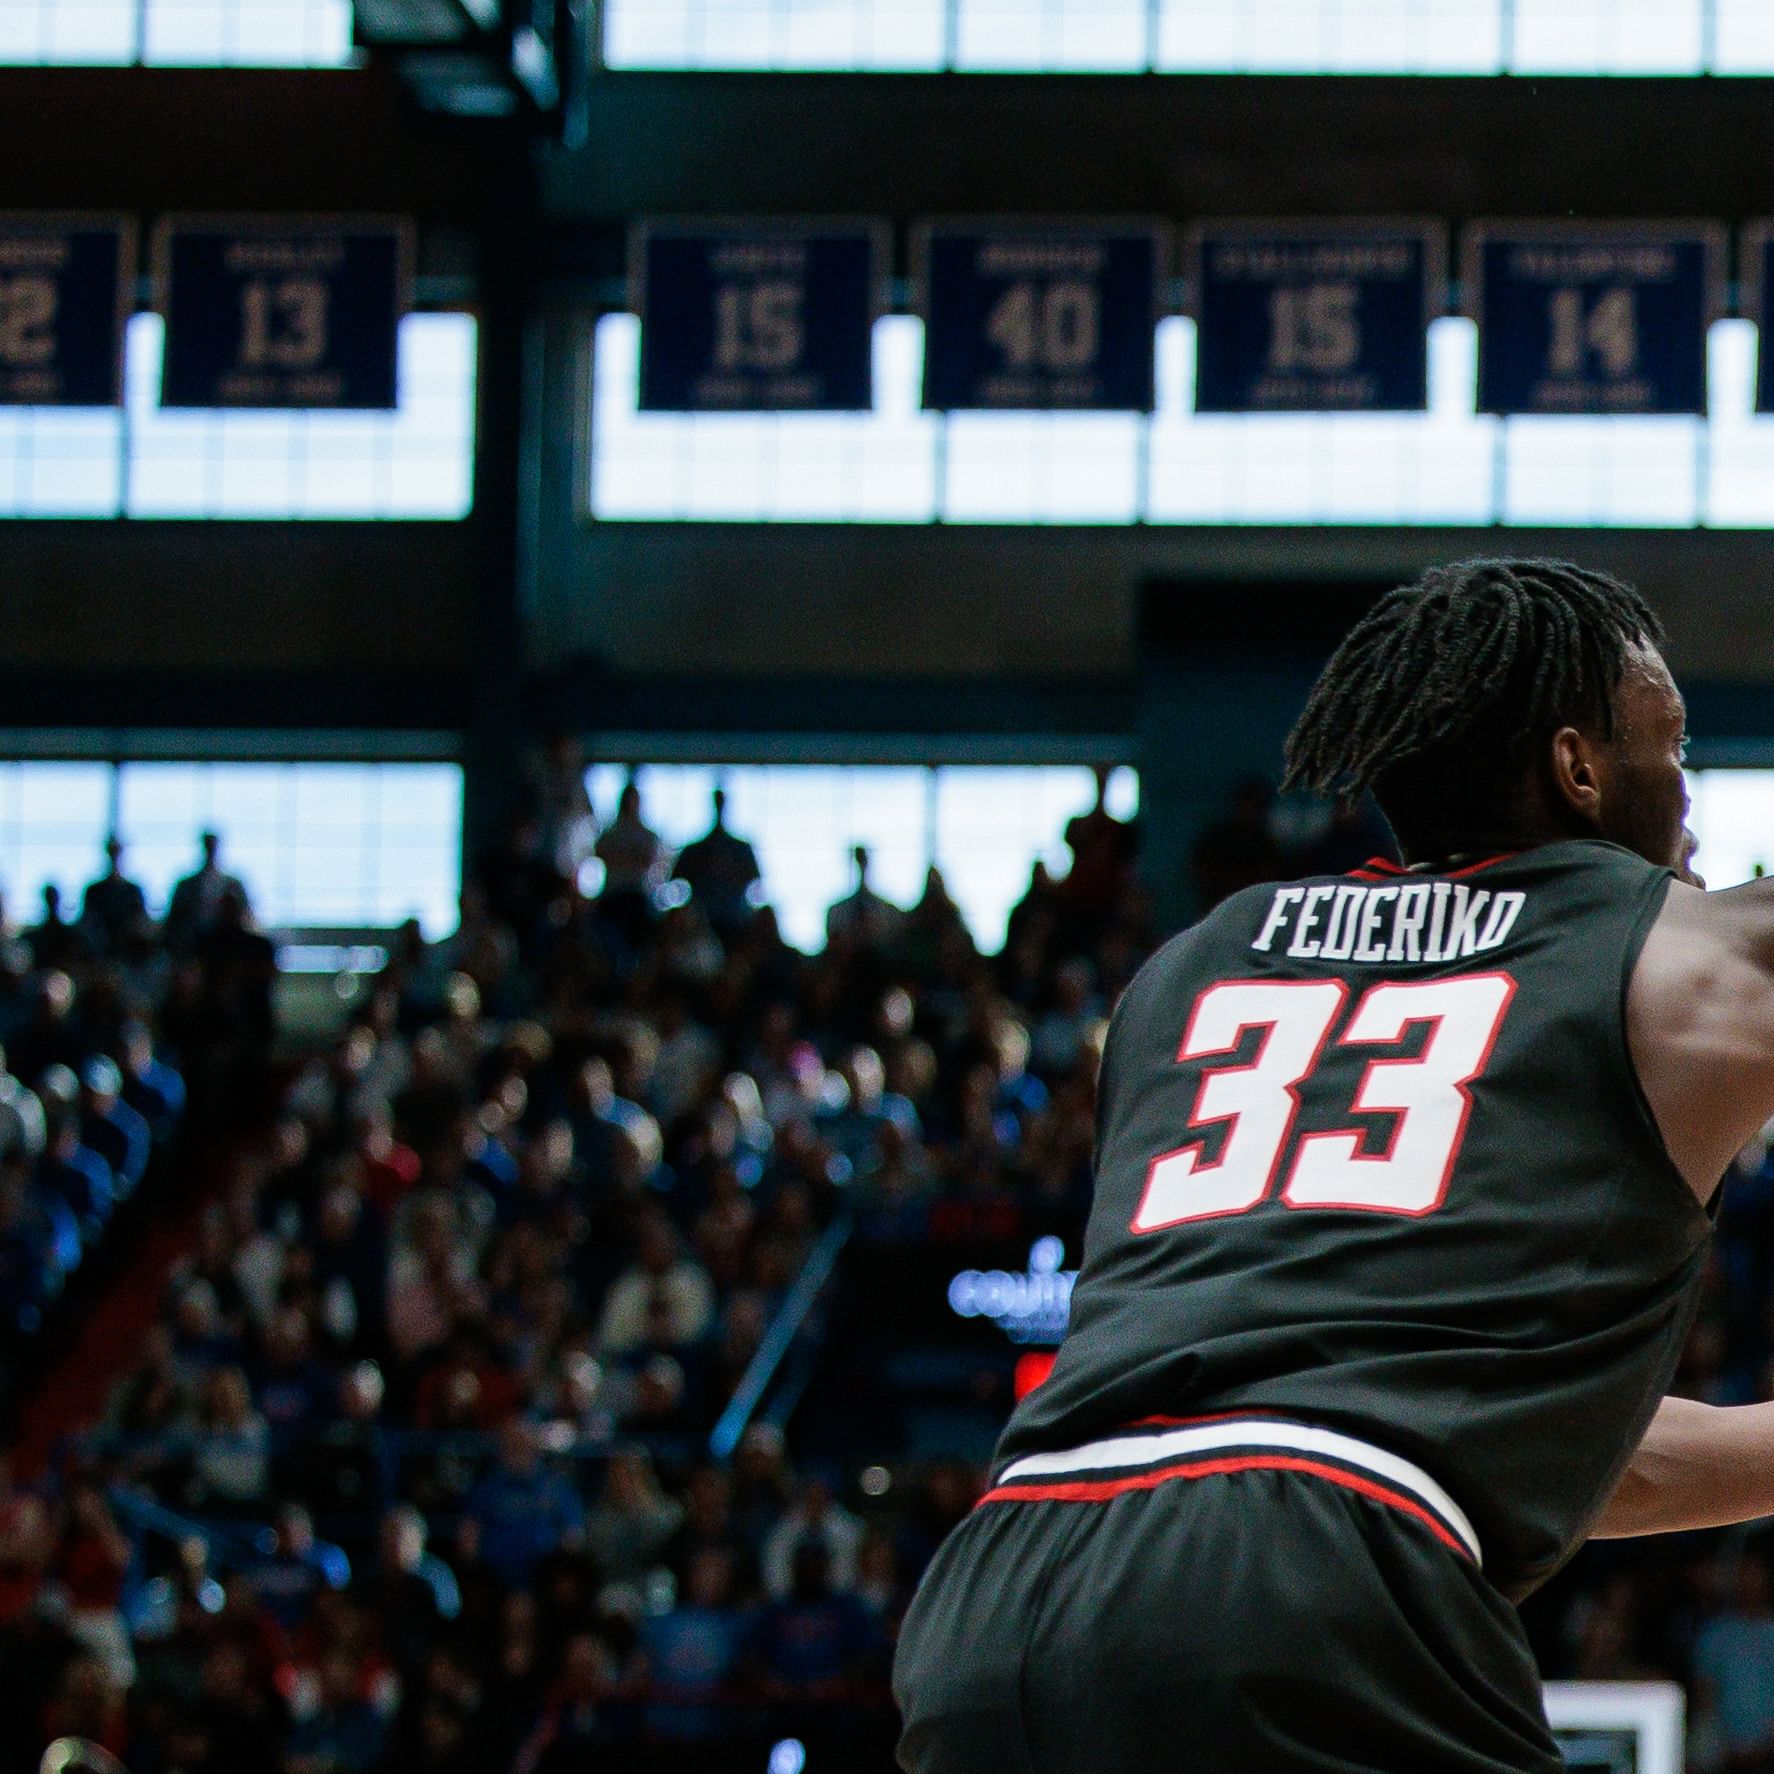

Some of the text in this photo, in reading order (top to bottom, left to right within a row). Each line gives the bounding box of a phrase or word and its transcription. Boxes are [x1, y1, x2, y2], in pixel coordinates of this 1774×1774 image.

[240, 279, 328, 366] 13
[713, 282, 802, 368] 15
[984, 282, 1100, 369] 40
[1266, 284, 1360, 370] 15
[1548, 287, 1638, 377] 14
[1252, 882, 1525, 962] FEDERIKO
[1129, 970, 1519, 1236] 33
